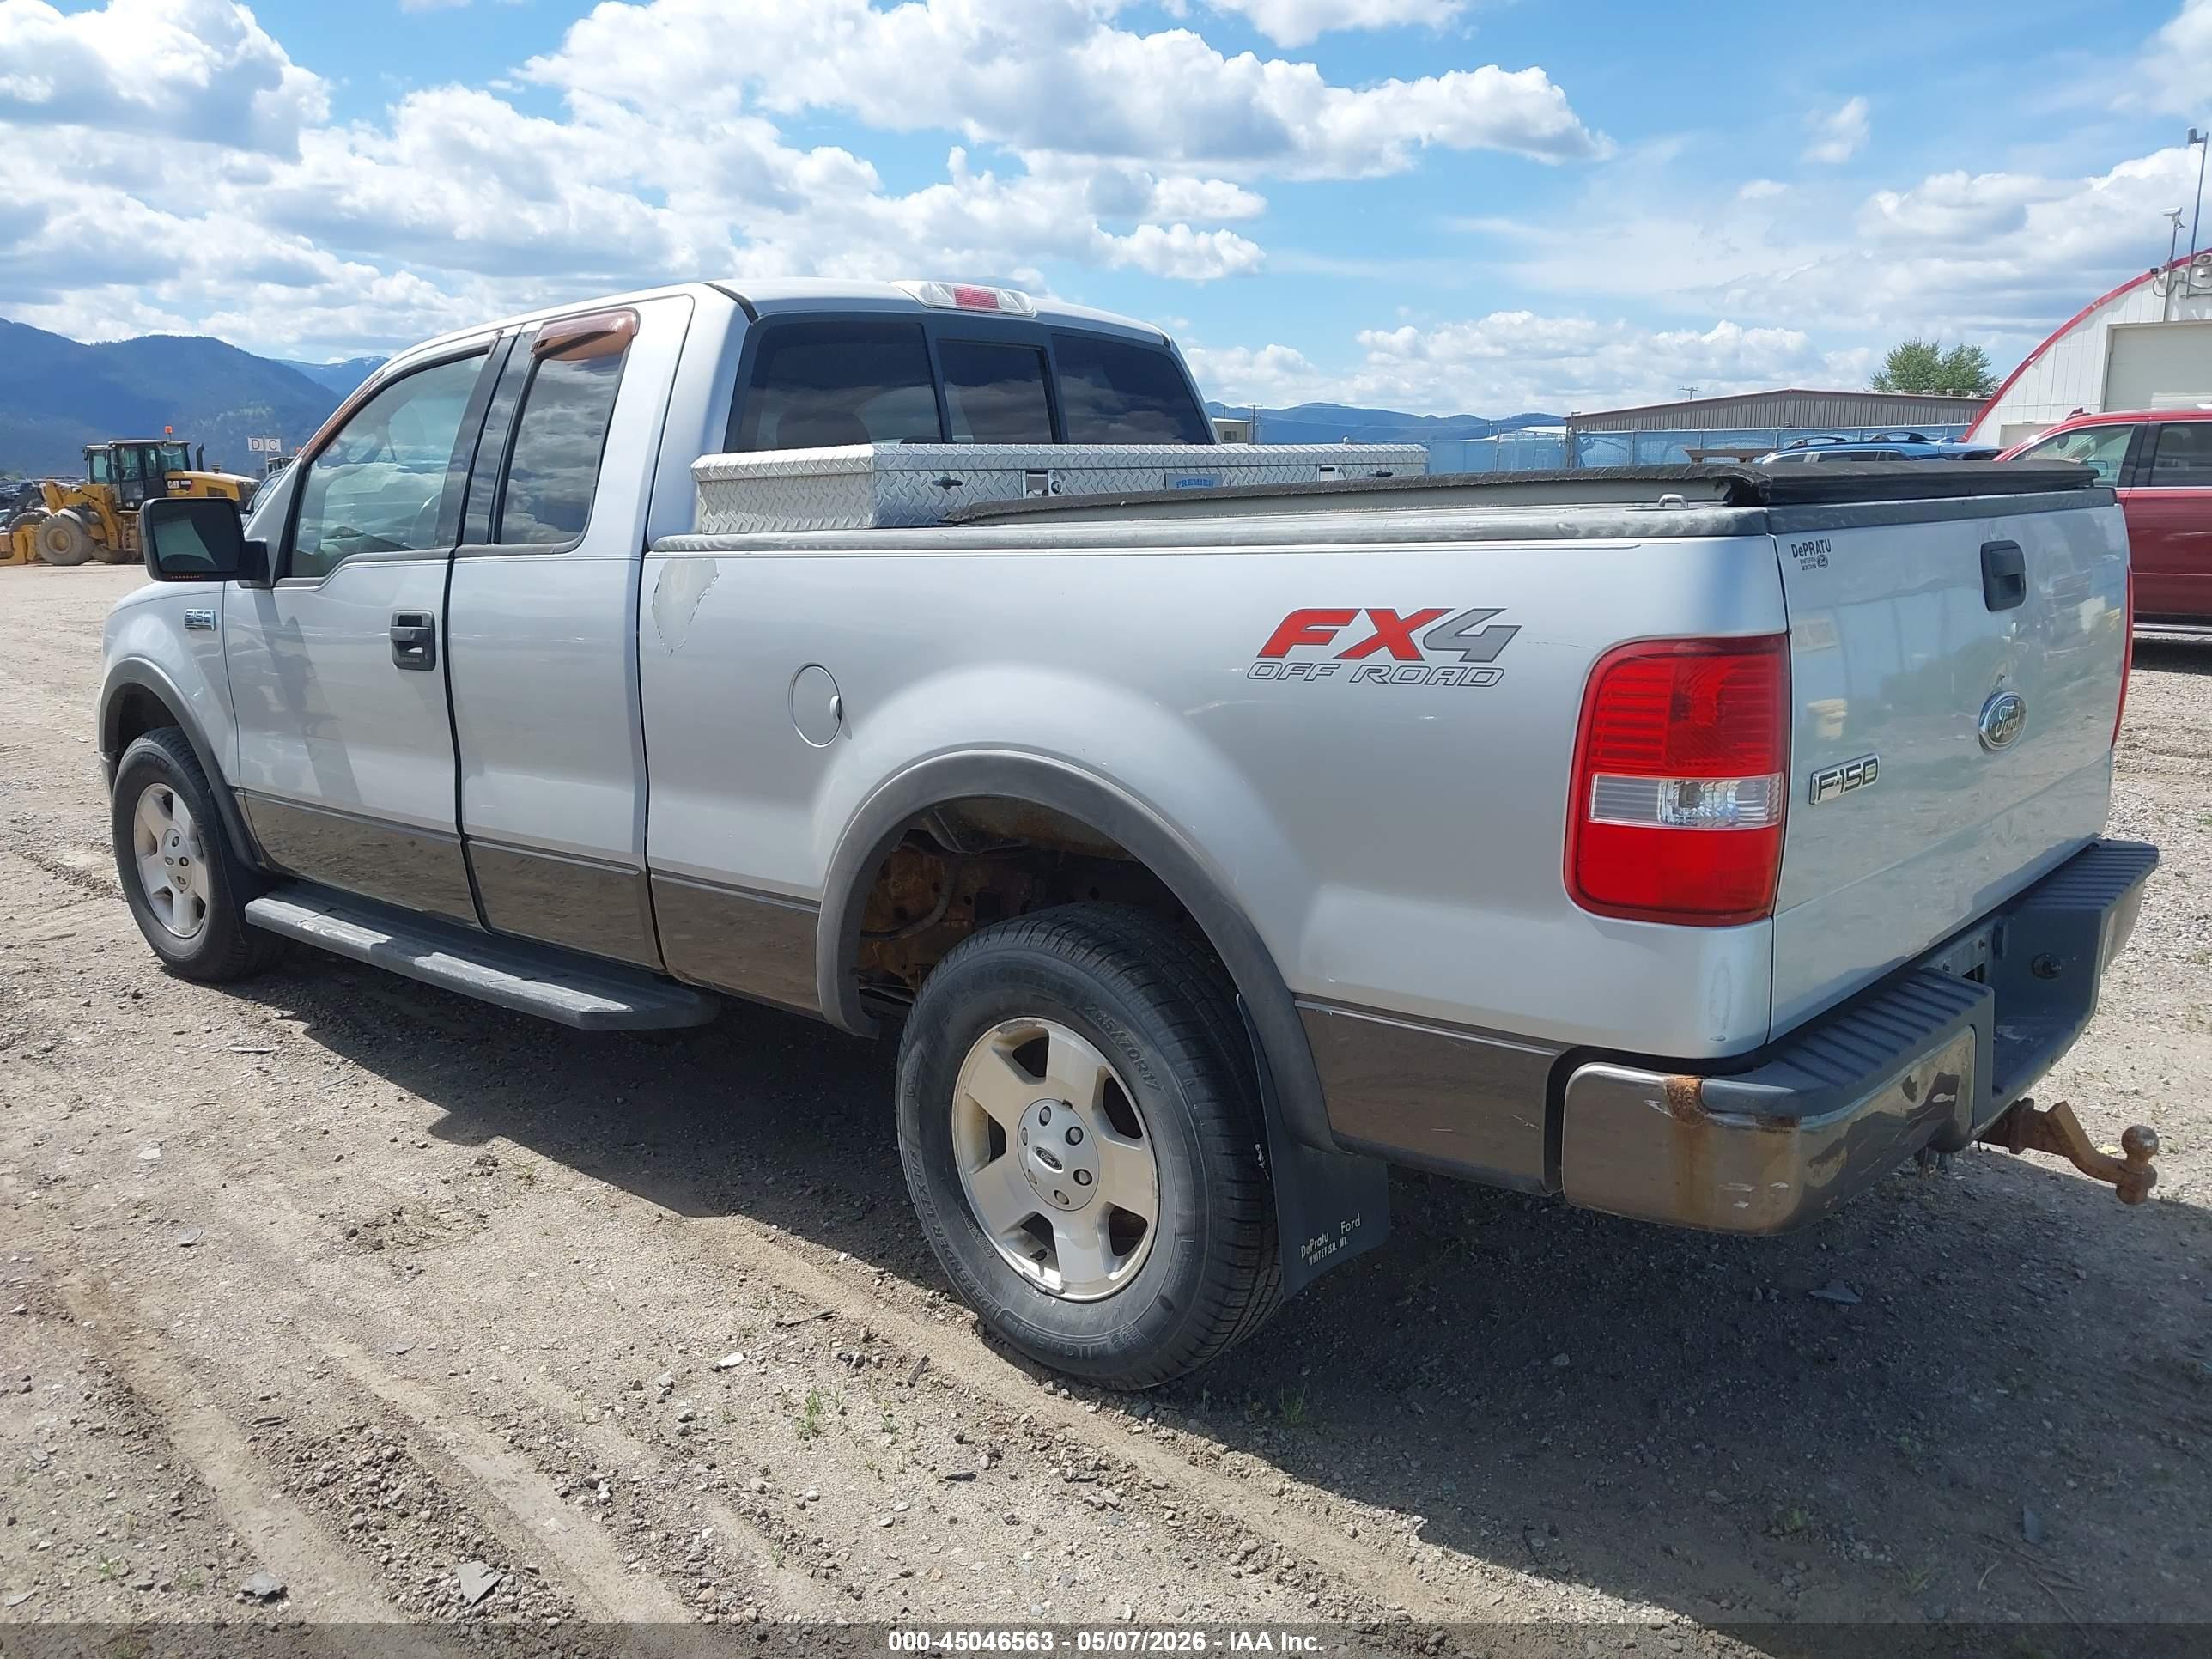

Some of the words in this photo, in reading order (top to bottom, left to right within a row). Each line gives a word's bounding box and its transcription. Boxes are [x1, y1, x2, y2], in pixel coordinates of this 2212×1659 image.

[252, 439, 260, 450] D
[269, 439, 277, 450] C
[167, 480, 179, 489] CAT
[1175, 477, 1214, 489] PREMIER
[1790, 538, 1832, 558] DePRATU
[1256, 608, 1523, 663] FX4
[1247, 662, 1342, 681] OFF
[1349, 664, 1505, 687] ROAD
[1340, 1212, 1361, 1235] Ford
